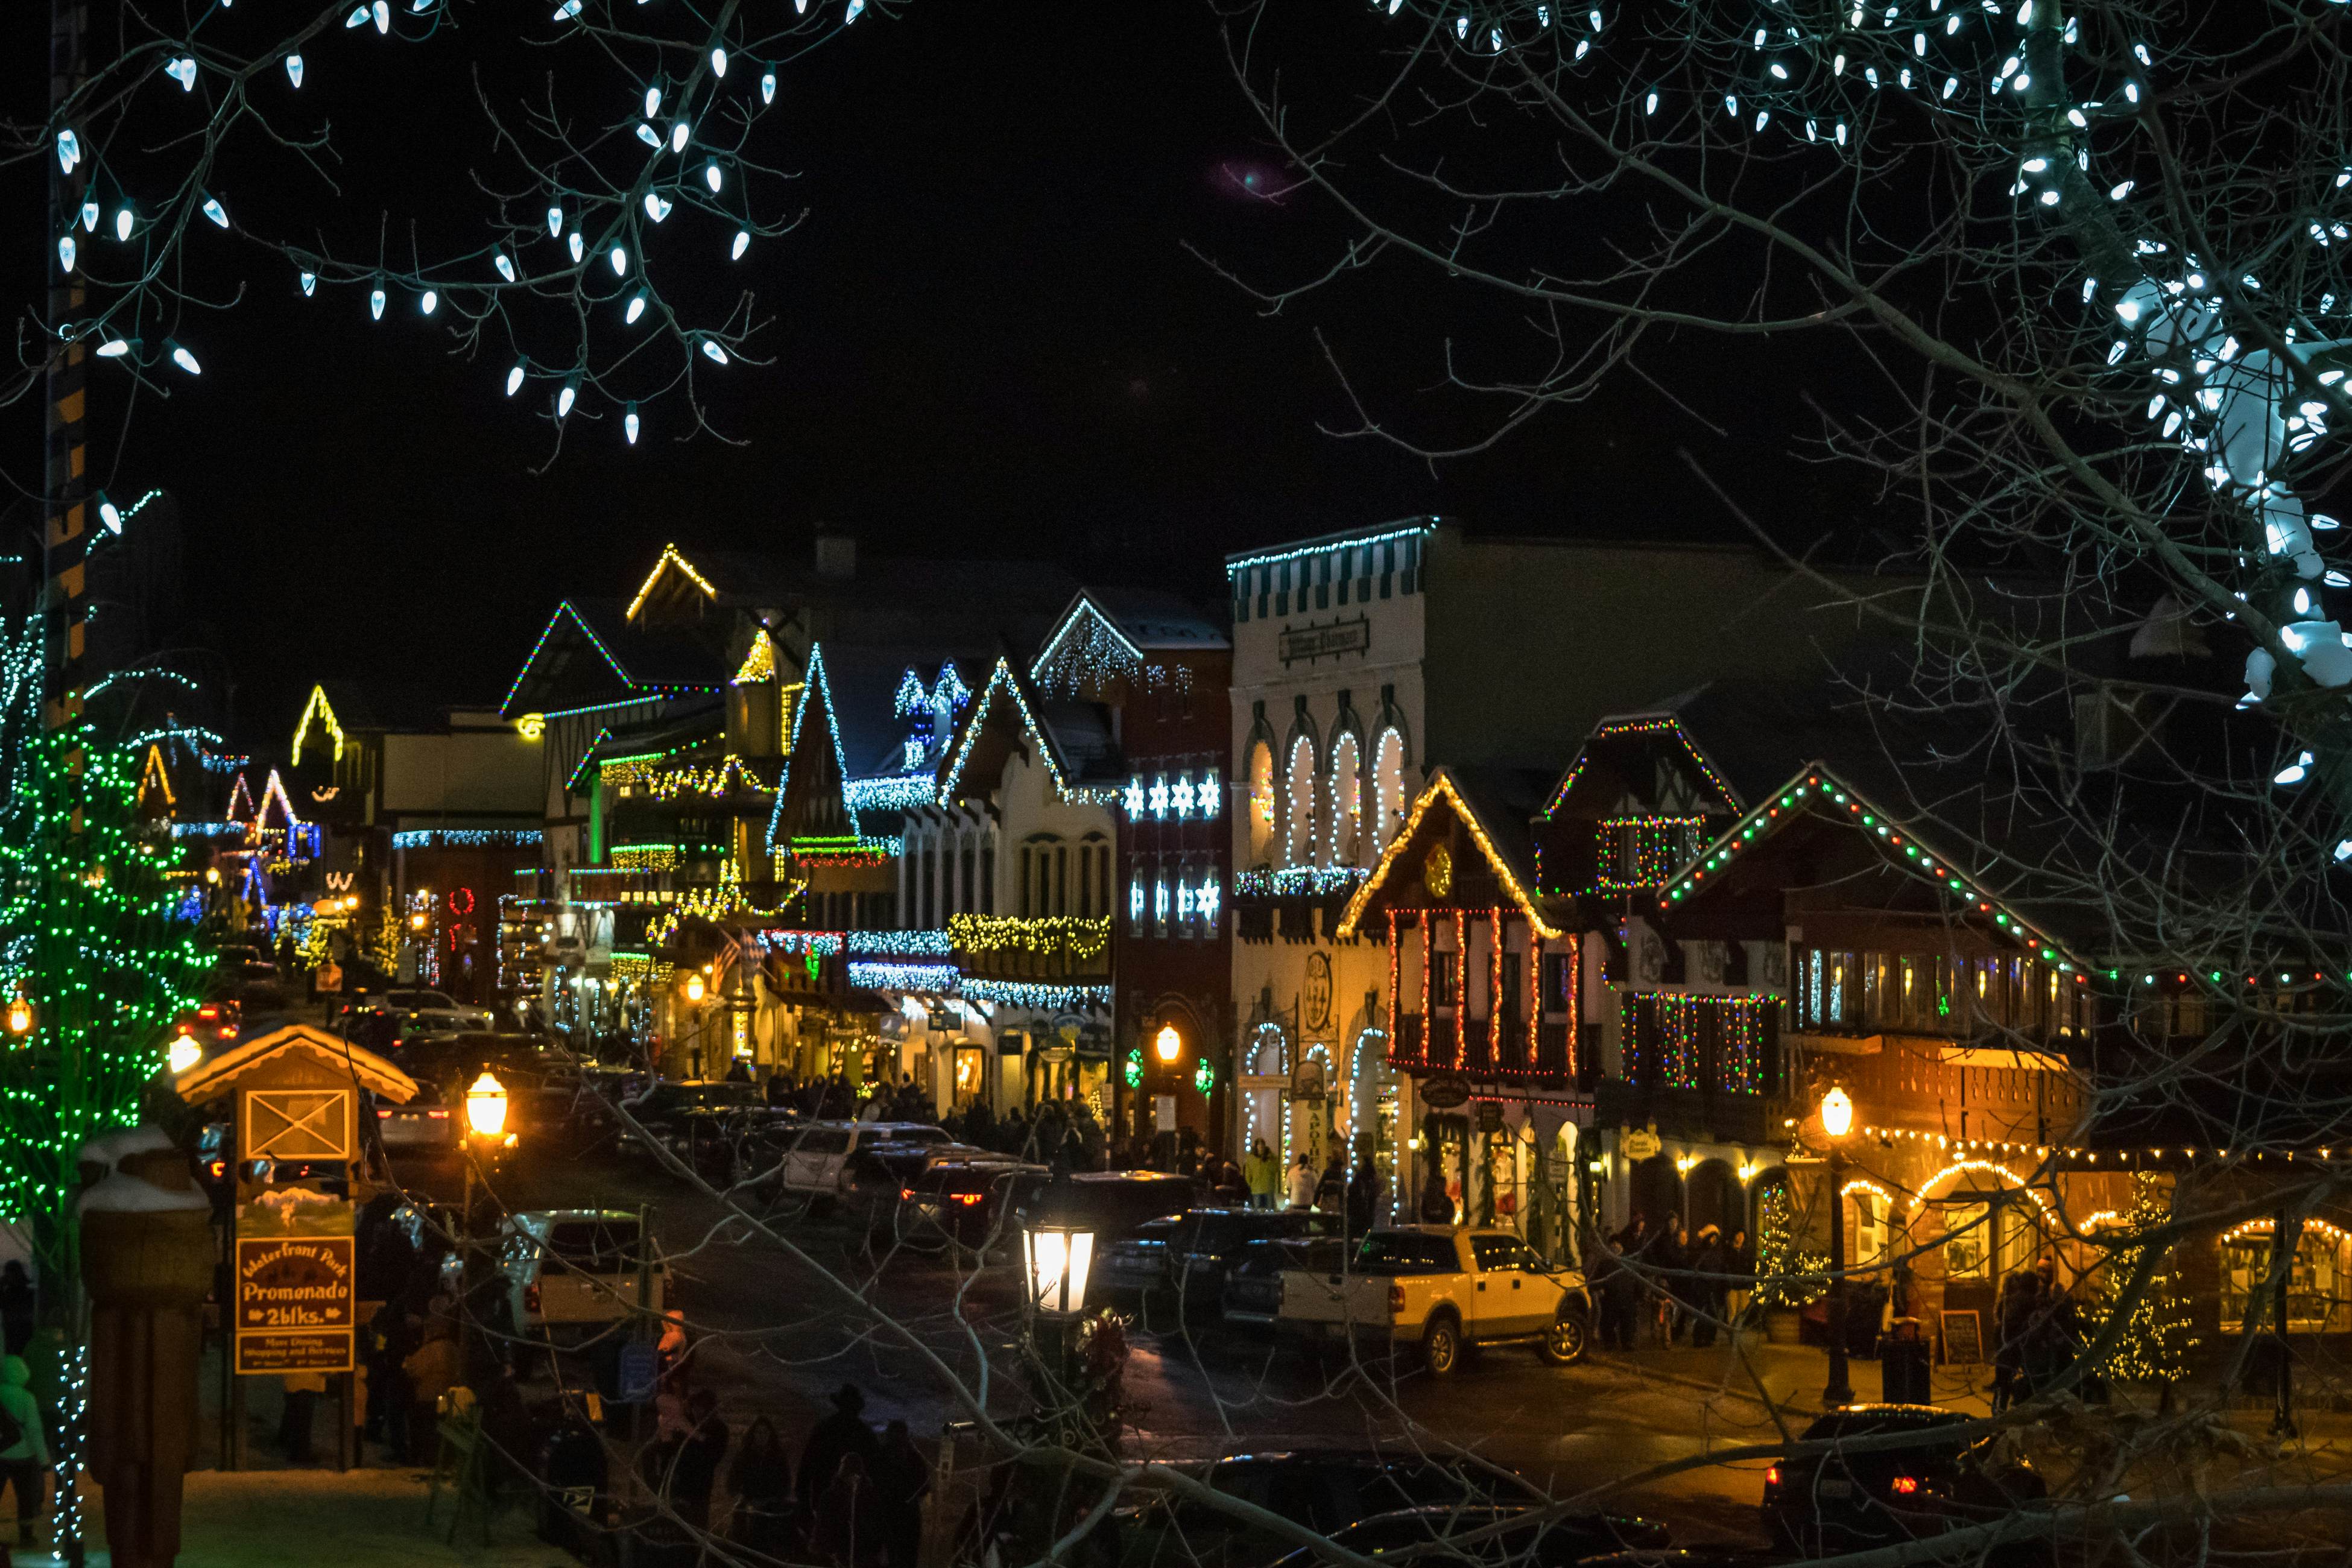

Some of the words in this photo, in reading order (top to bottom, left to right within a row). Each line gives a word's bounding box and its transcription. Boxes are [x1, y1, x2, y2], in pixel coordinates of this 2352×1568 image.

[242, 1242, 318, 1278] Waterfront
[319, 1248, 348, 1278] Park
[242, 1280, 348, 1301] Promenade
